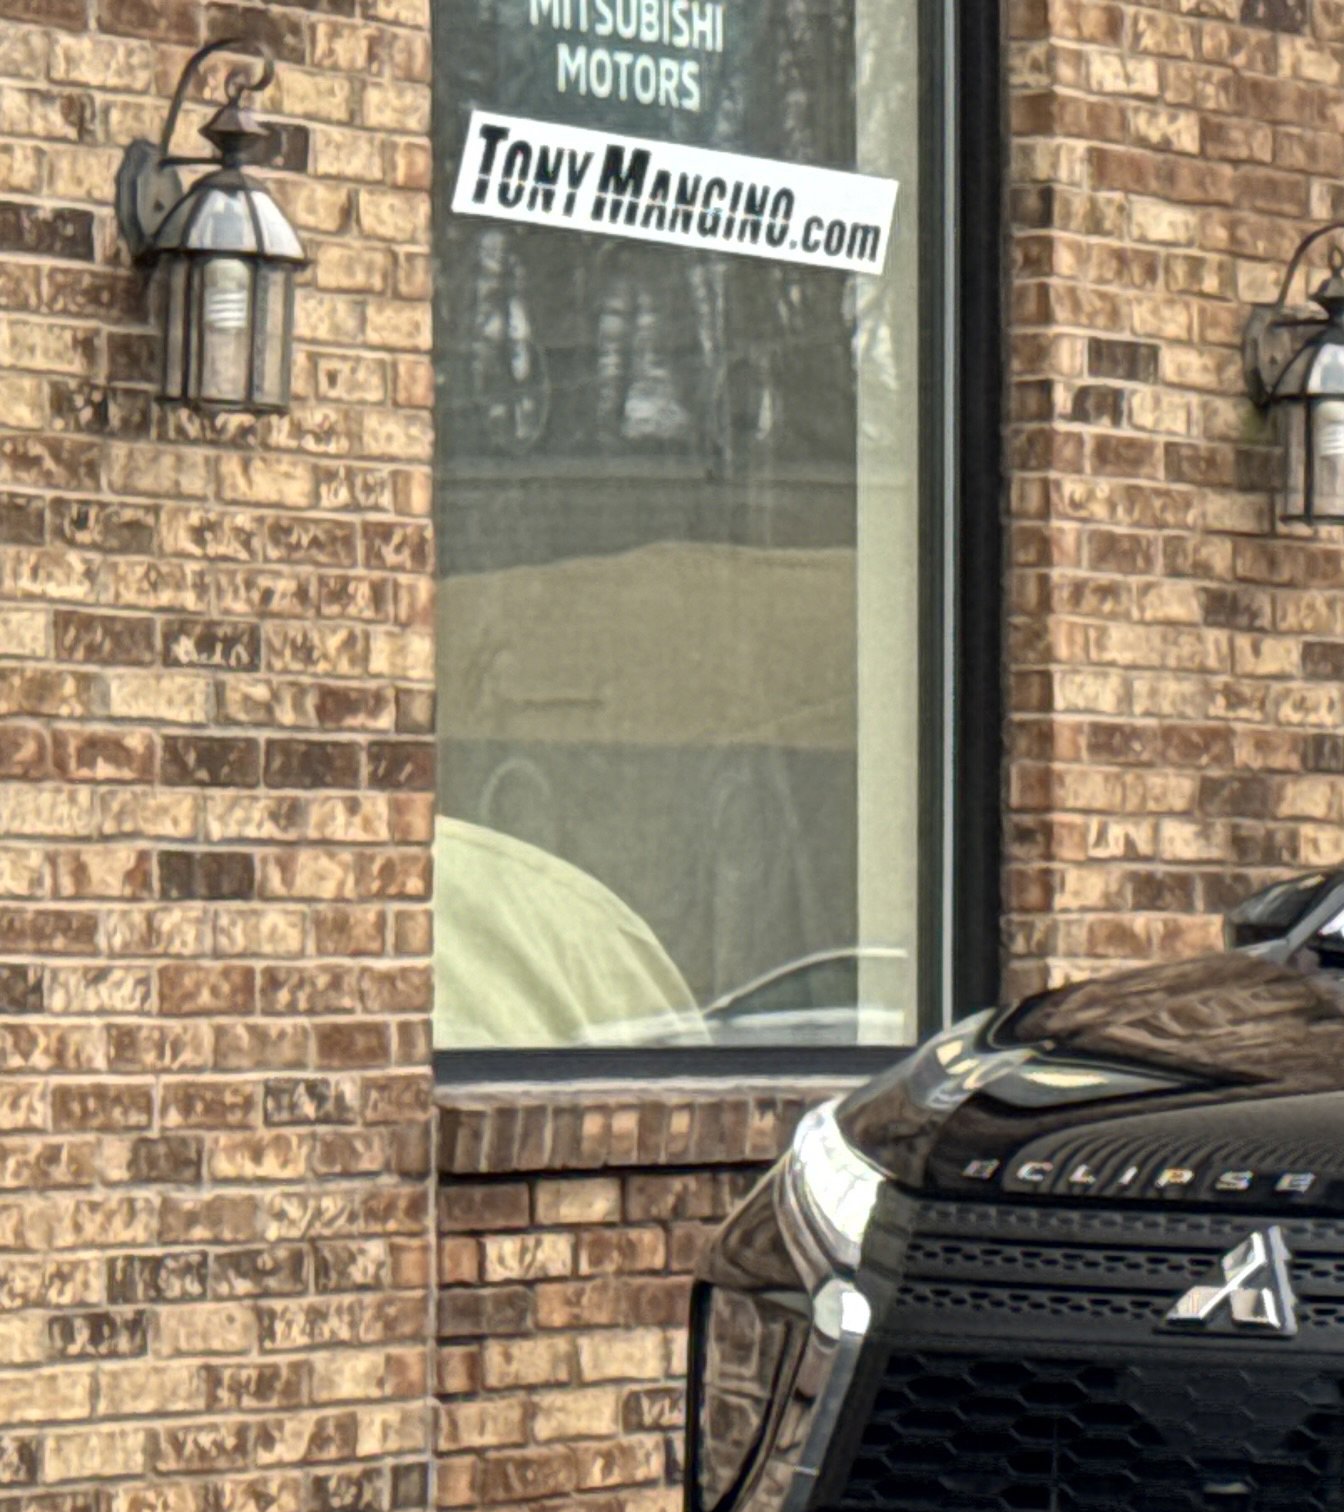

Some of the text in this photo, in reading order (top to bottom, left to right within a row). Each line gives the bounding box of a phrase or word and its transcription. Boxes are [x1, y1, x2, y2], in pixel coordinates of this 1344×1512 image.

[529, 0, 725, 53] MITSUBISHI
[556, 43, 700, 112] MOTORS
[963, 1158, 1316, 1194] ECLIPSE
